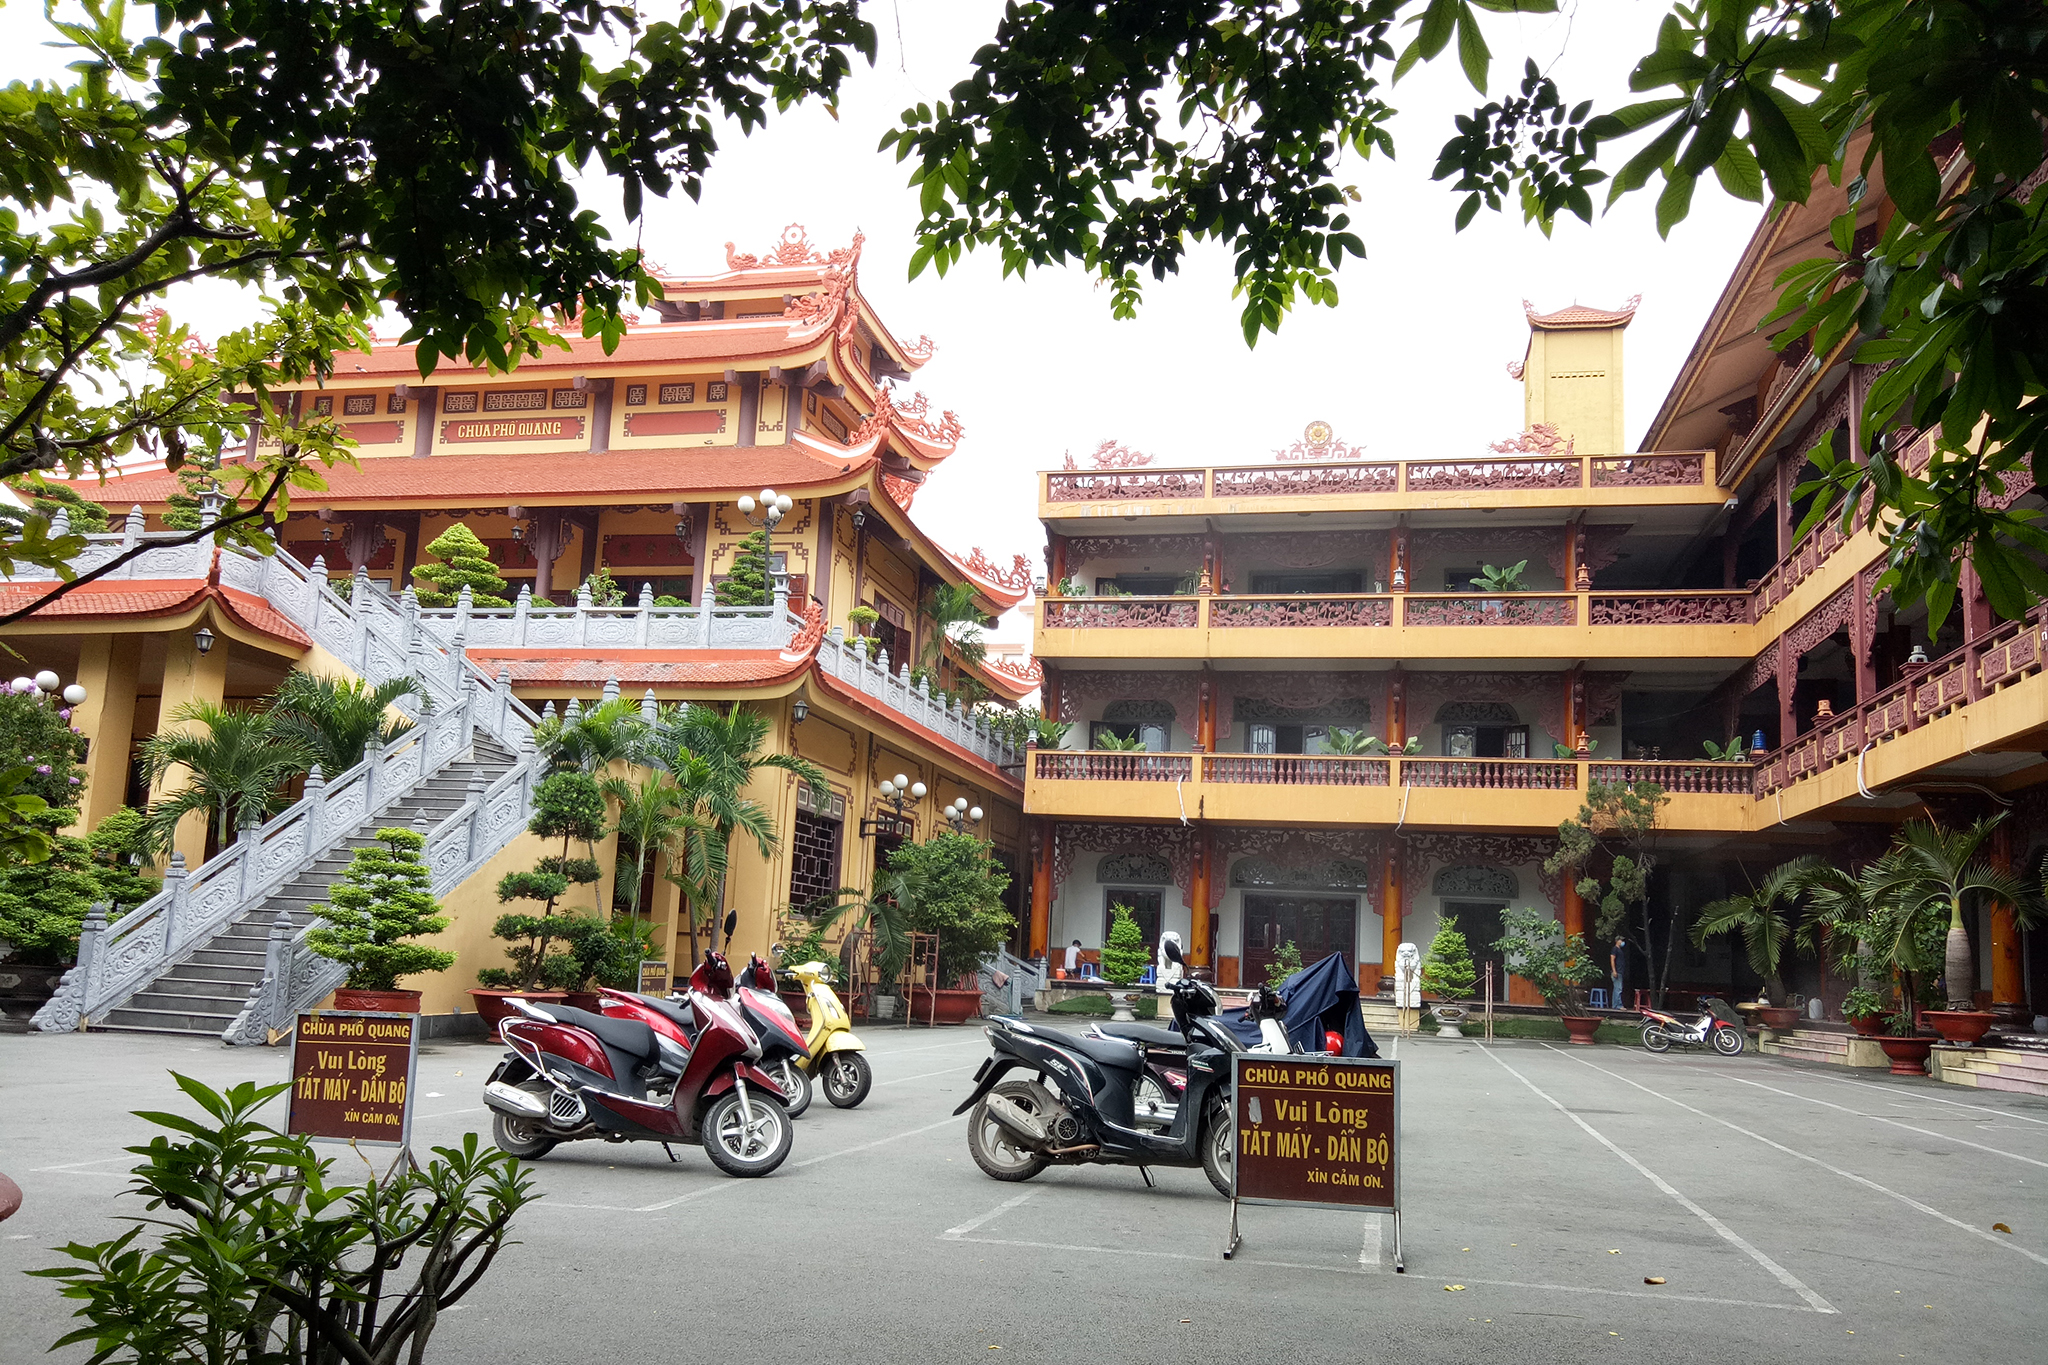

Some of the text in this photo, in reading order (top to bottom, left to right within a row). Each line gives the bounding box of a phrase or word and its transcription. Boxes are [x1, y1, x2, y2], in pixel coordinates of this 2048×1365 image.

[458, 422, 491, 438] CHÙA
[518, 421, 562, 436] QUANG
[302, 1018, 410, 1039] CHÙA PHỔ QUANG
[318, 1050, 387, 1074] Vui Lòng
[298, 1065, 321, 1100] TẮT
[323, 1073, 350, 1101] MÁY
[360, 1073, 386, 1103] DẪN
[388, 1076, 406, 1109] BỘ
[1245, 1065, 1391, 1089] CHÙA PHỔ QUANG
[361, 1107, 383, 1124] CẢM
[1274, 1099, 1368, 1129] Vui Lòng
[1276, 1127, 1312, 1159] MÁY
[1327, 1129, 1361, 1163] DẪN
[1366, 1132, 1389, 1171] BỘ
[1331, 1169, 1360, 1186] CẢM
[1363, 1174, 1384, 1188] ƠN.
